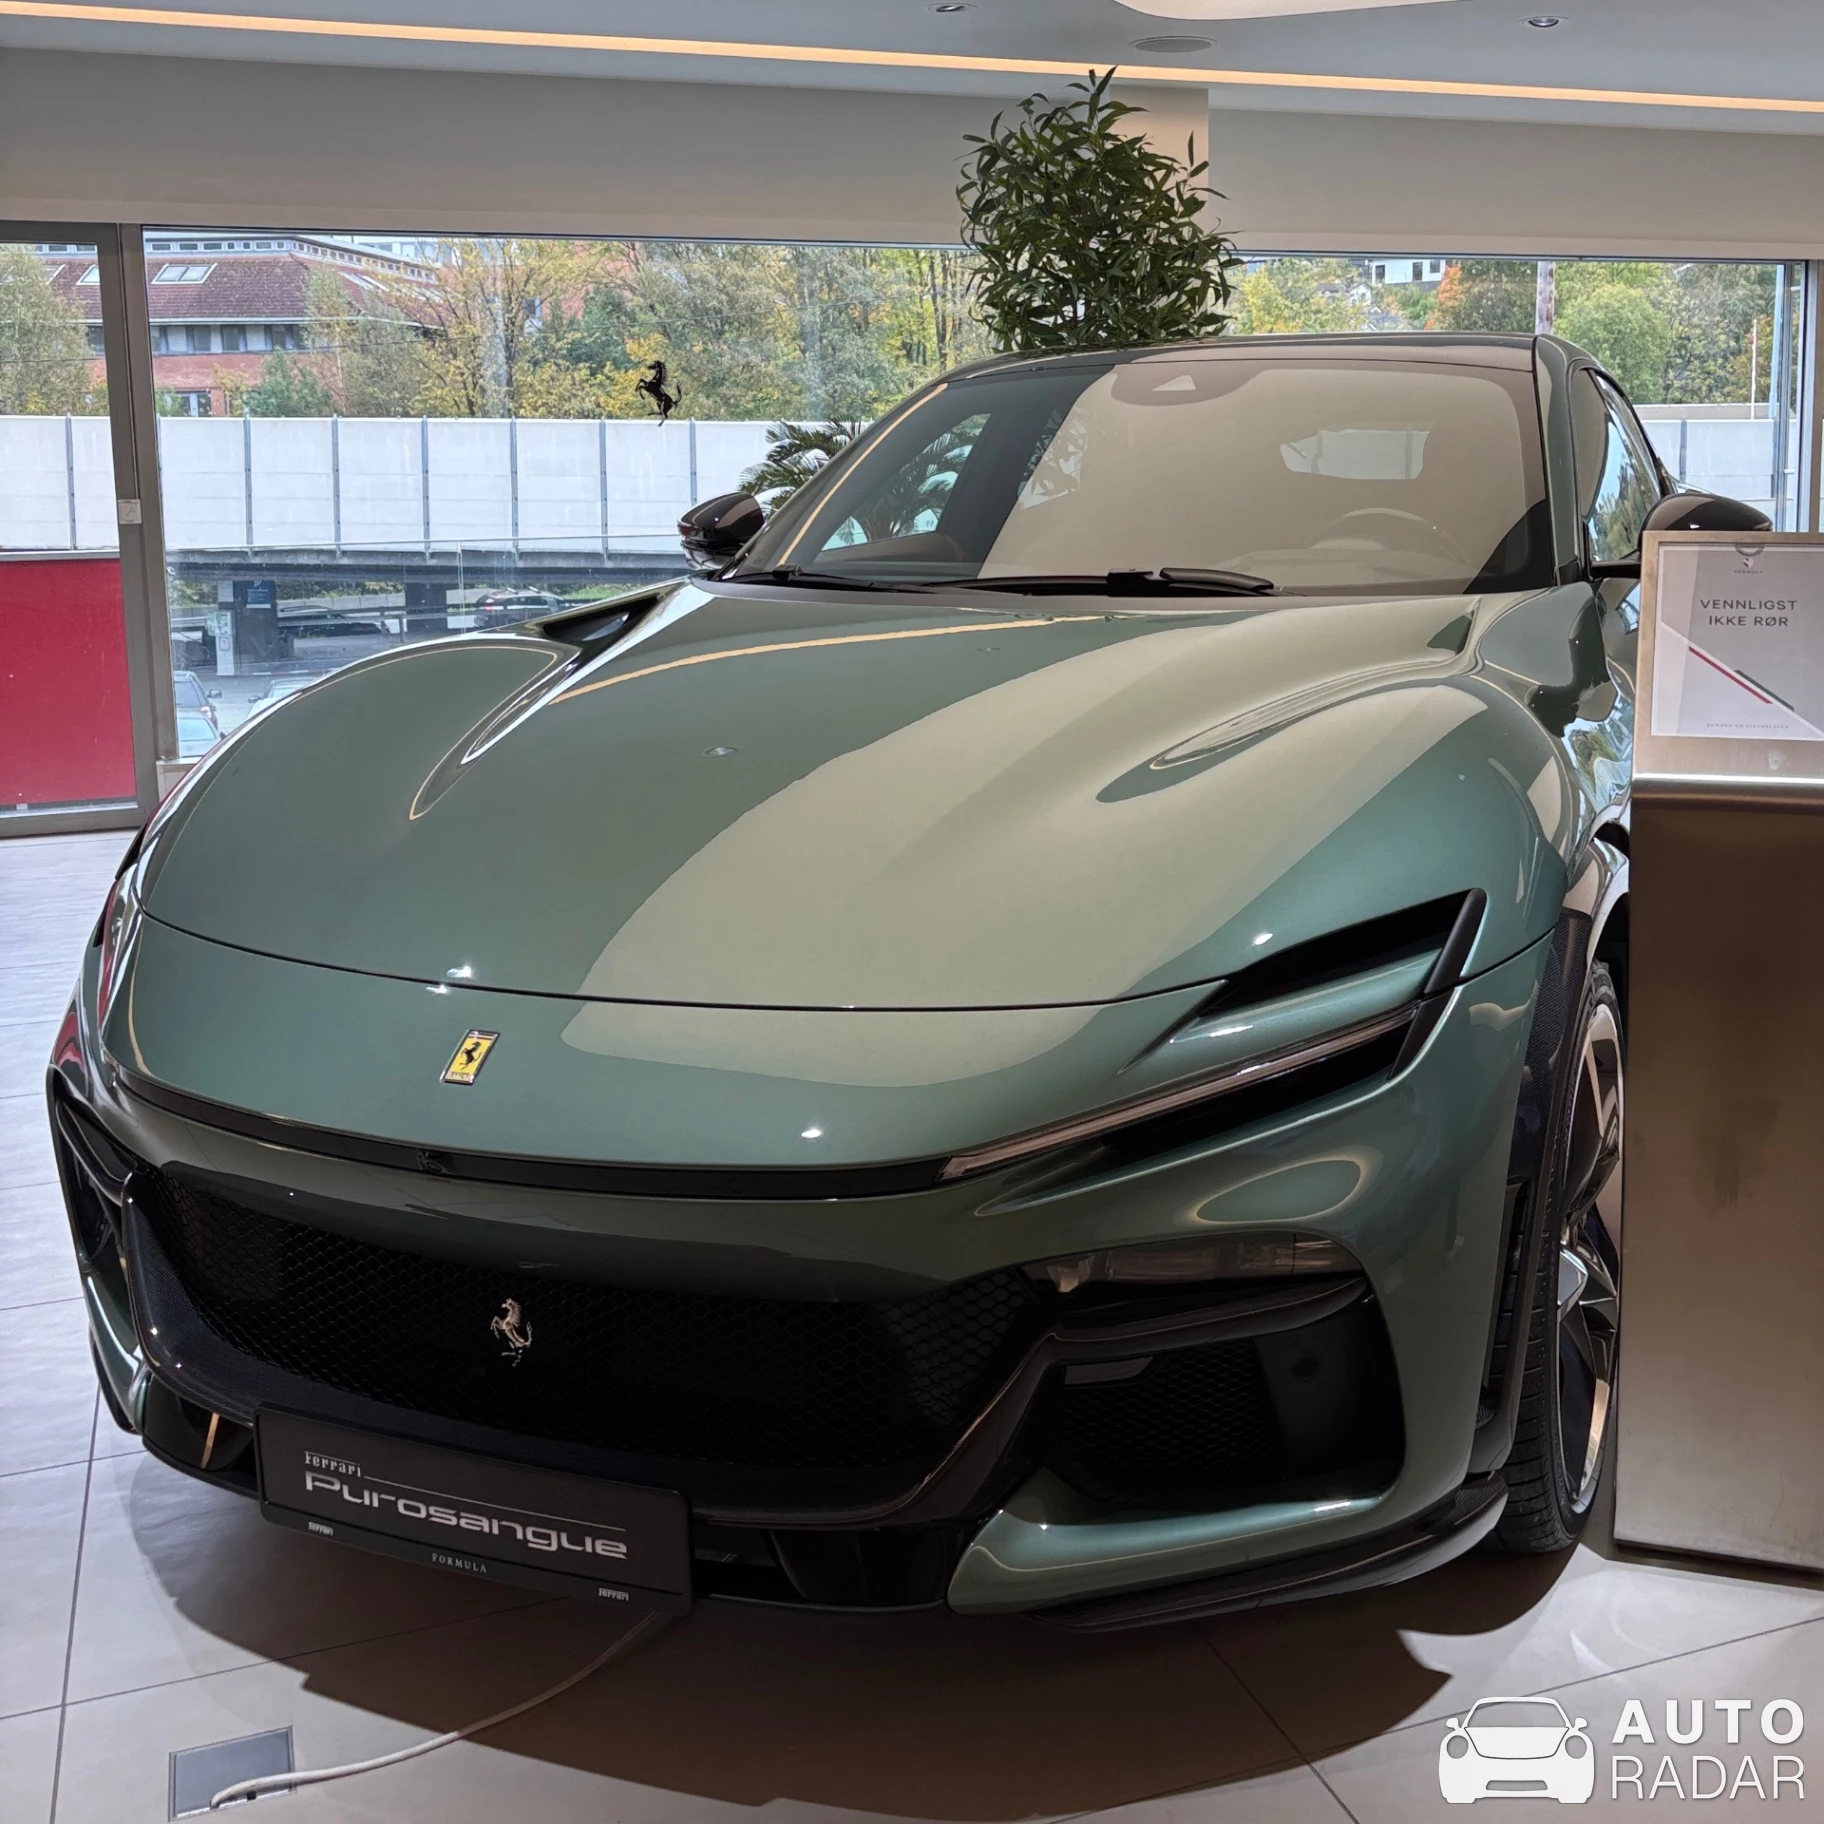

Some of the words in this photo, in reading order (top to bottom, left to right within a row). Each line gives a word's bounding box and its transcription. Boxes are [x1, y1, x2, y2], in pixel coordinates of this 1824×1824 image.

[1700, 599, 1798, 610] VENNLIGST
[1709, 615, 1747, 626] IKKE
[1754, 616, 1788, 626] RØR
[305, 1450, 361, 1477] Ferrari
[305, 1470, 628, 1560] Purosangue
[432, 1552, 487, 1573] FORMULA
